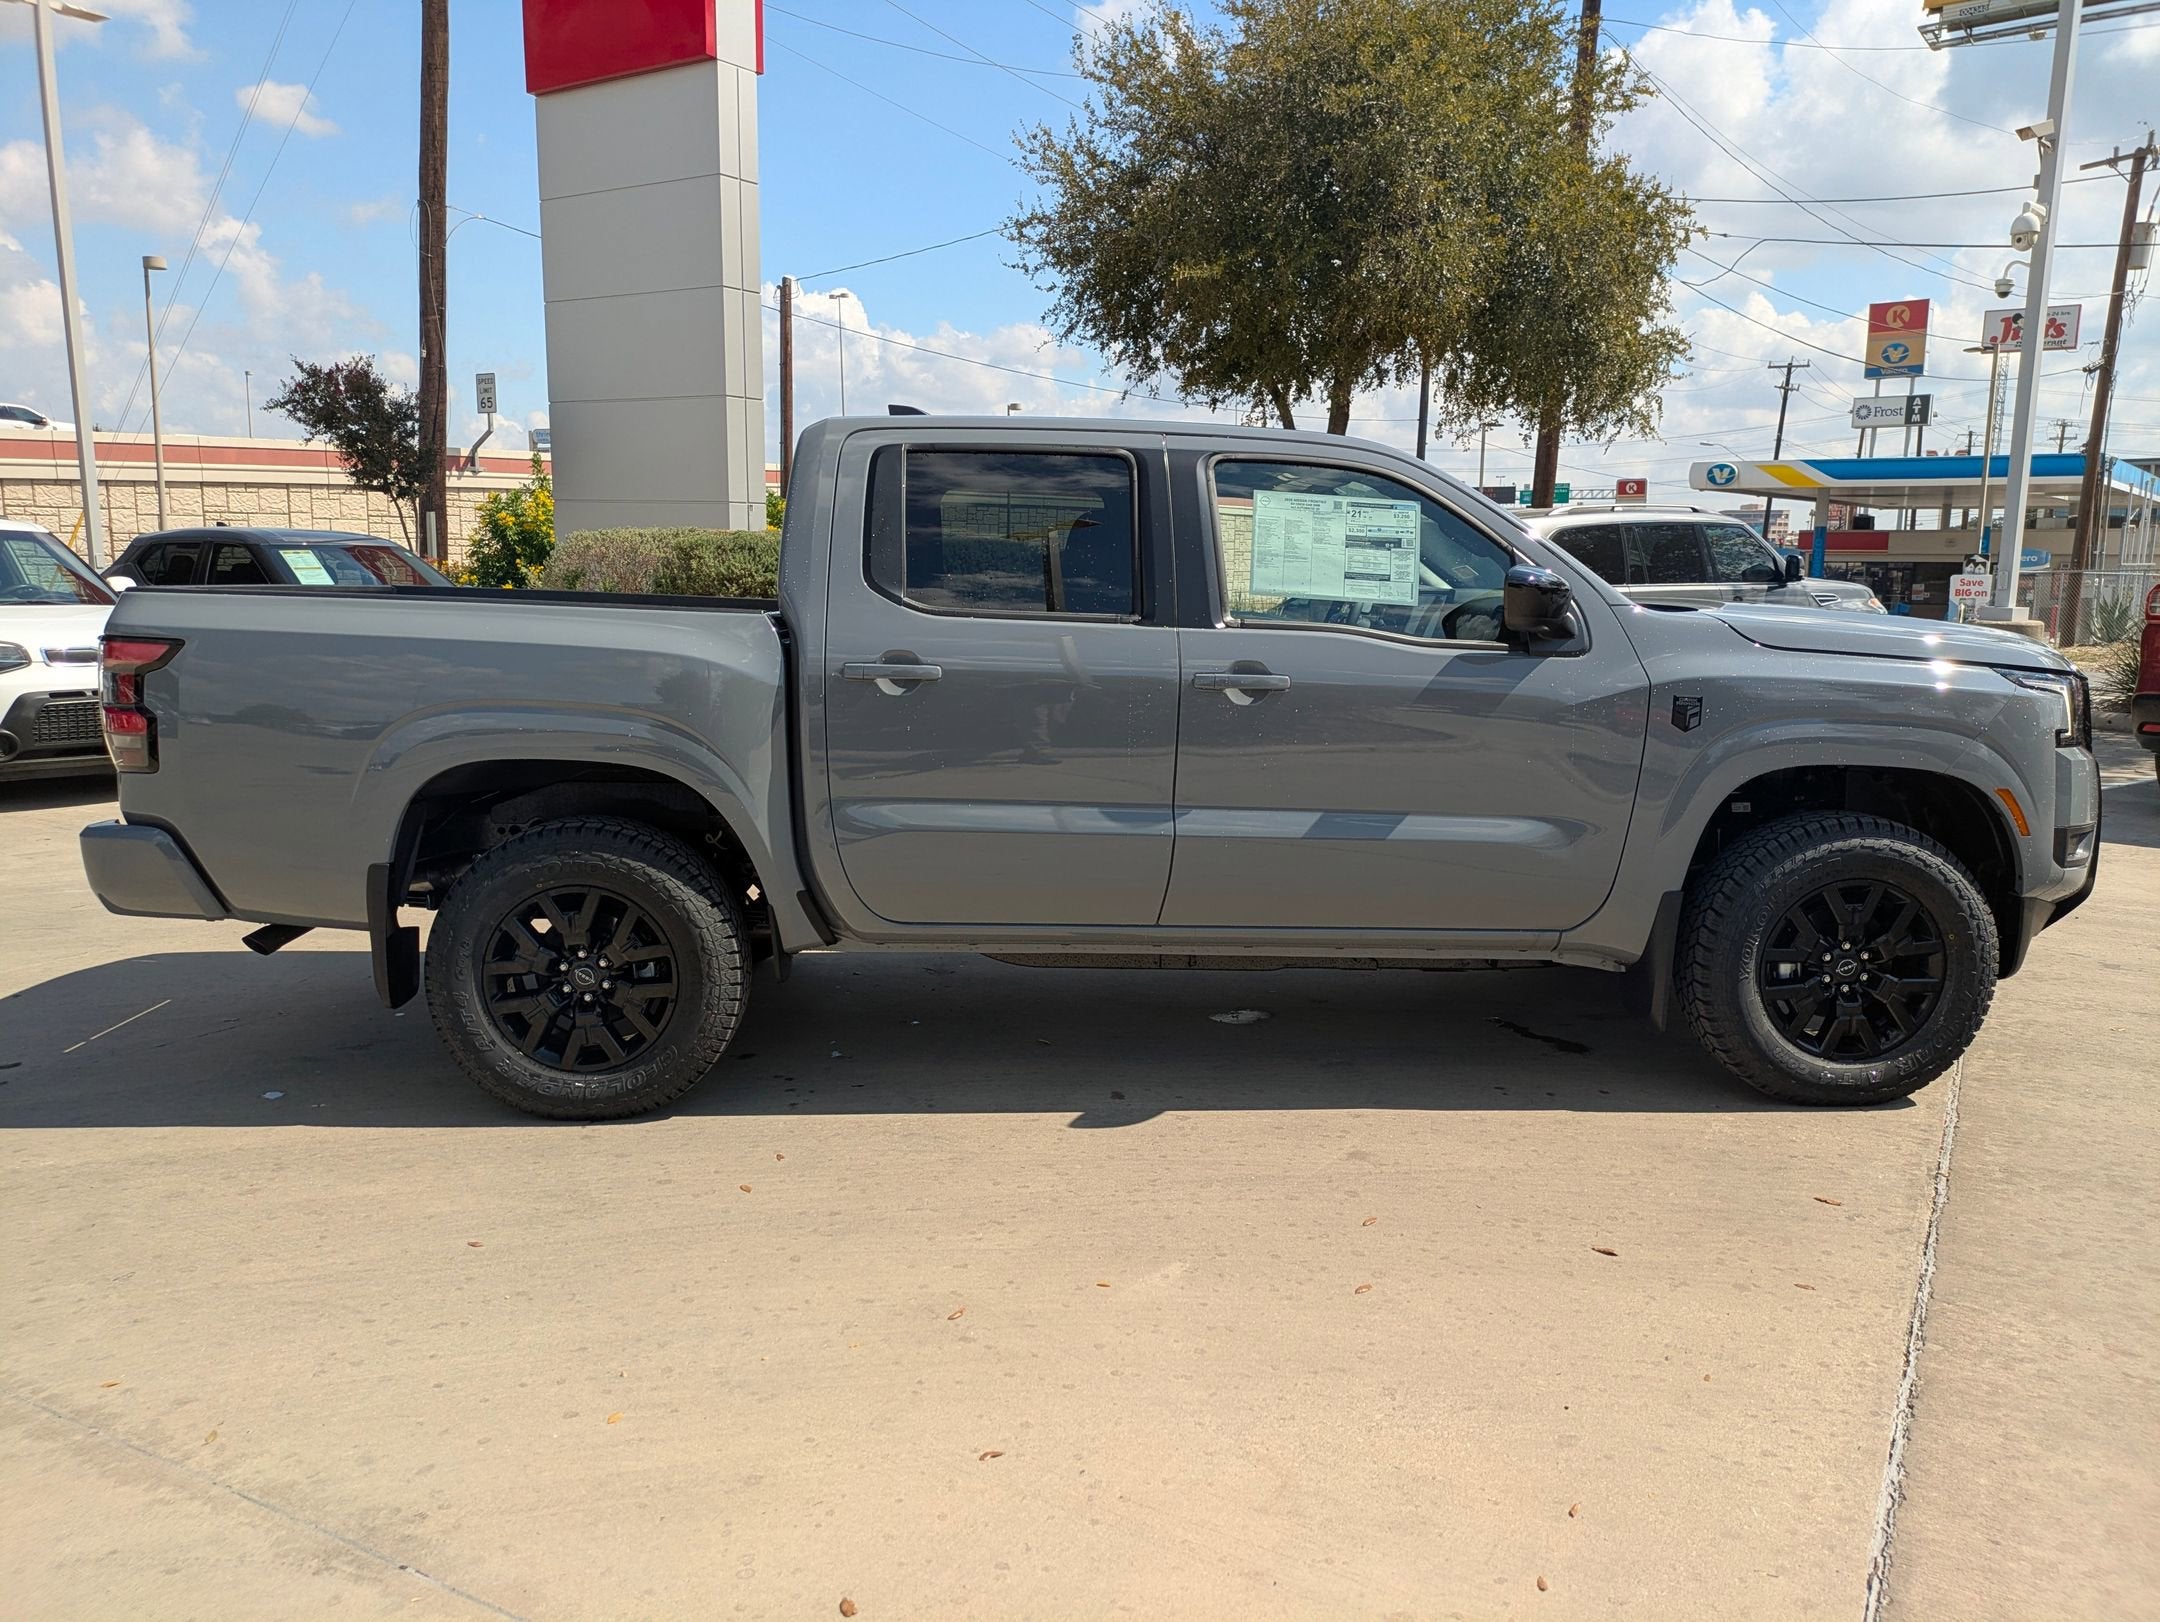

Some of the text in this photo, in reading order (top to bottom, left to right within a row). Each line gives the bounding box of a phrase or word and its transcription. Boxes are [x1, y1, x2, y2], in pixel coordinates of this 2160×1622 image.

[1990, 316, 2067, 345] Ji's
[480, 396, 493, 409] 65
[1873, 406, 1904, 418] Frost
[1911, 397, 1922, 423] ATM
[1351, 509, 1362, 518] 21
[1959, 578, 1984, 587] Save
[1954, 589, 1972, 597] BIG
